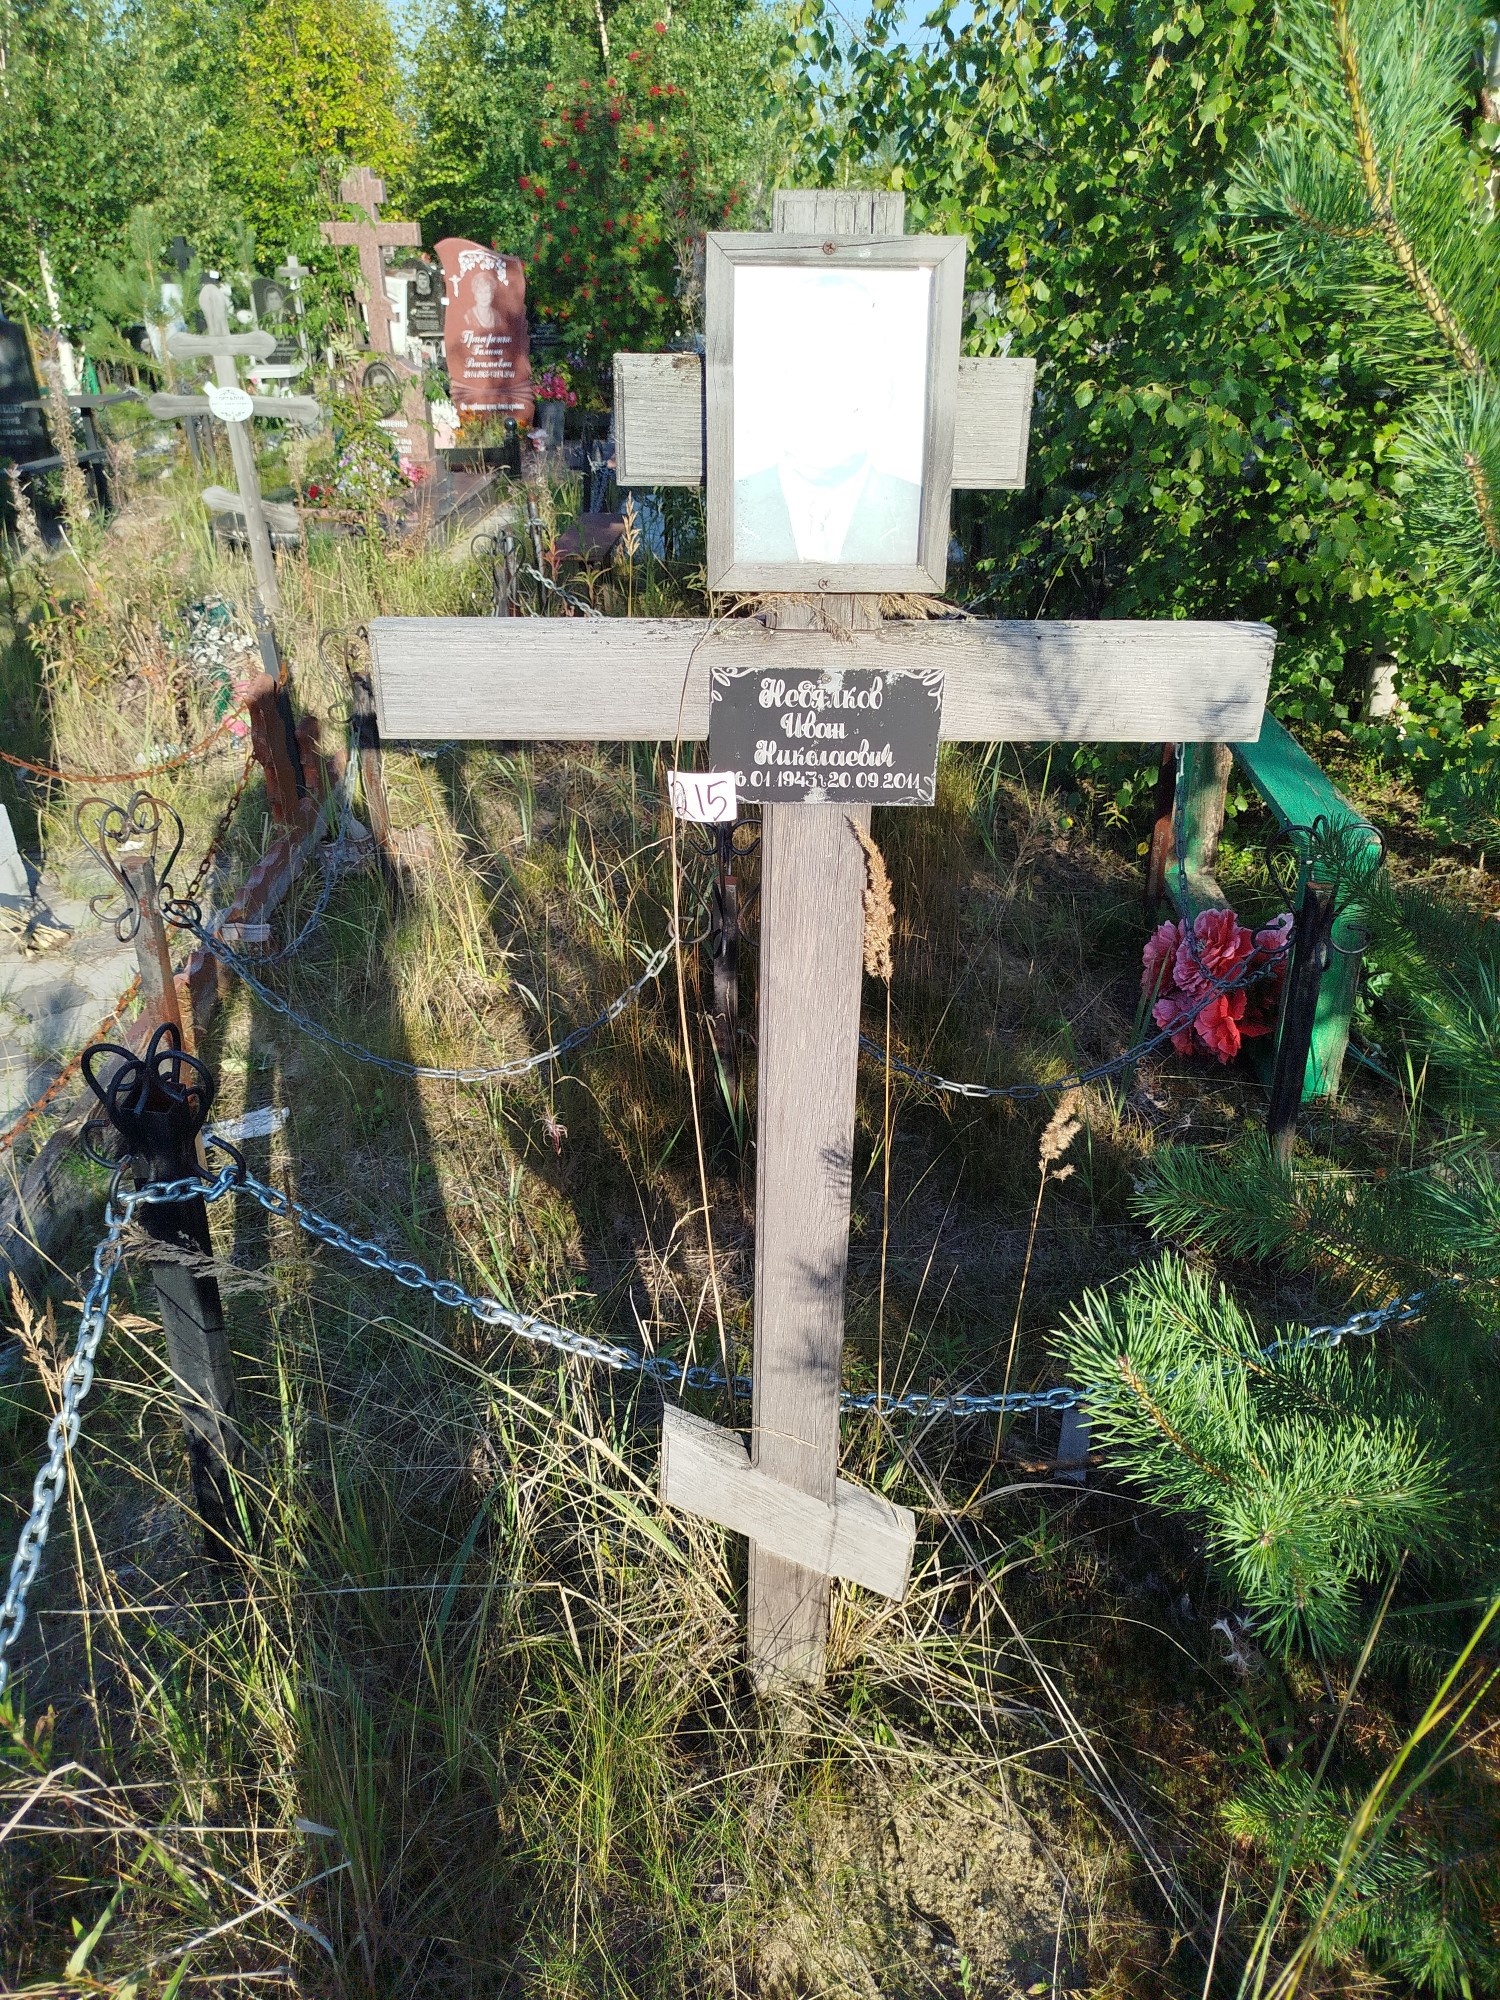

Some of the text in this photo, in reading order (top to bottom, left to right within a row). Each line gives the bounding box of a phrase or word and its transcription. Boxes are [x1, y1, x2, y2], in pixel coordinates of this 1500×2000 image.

[758, 676, 883, 710] Недялков
[780, 710, 849, 739] Иван
[753, 738, 897, 768] Николаевич
